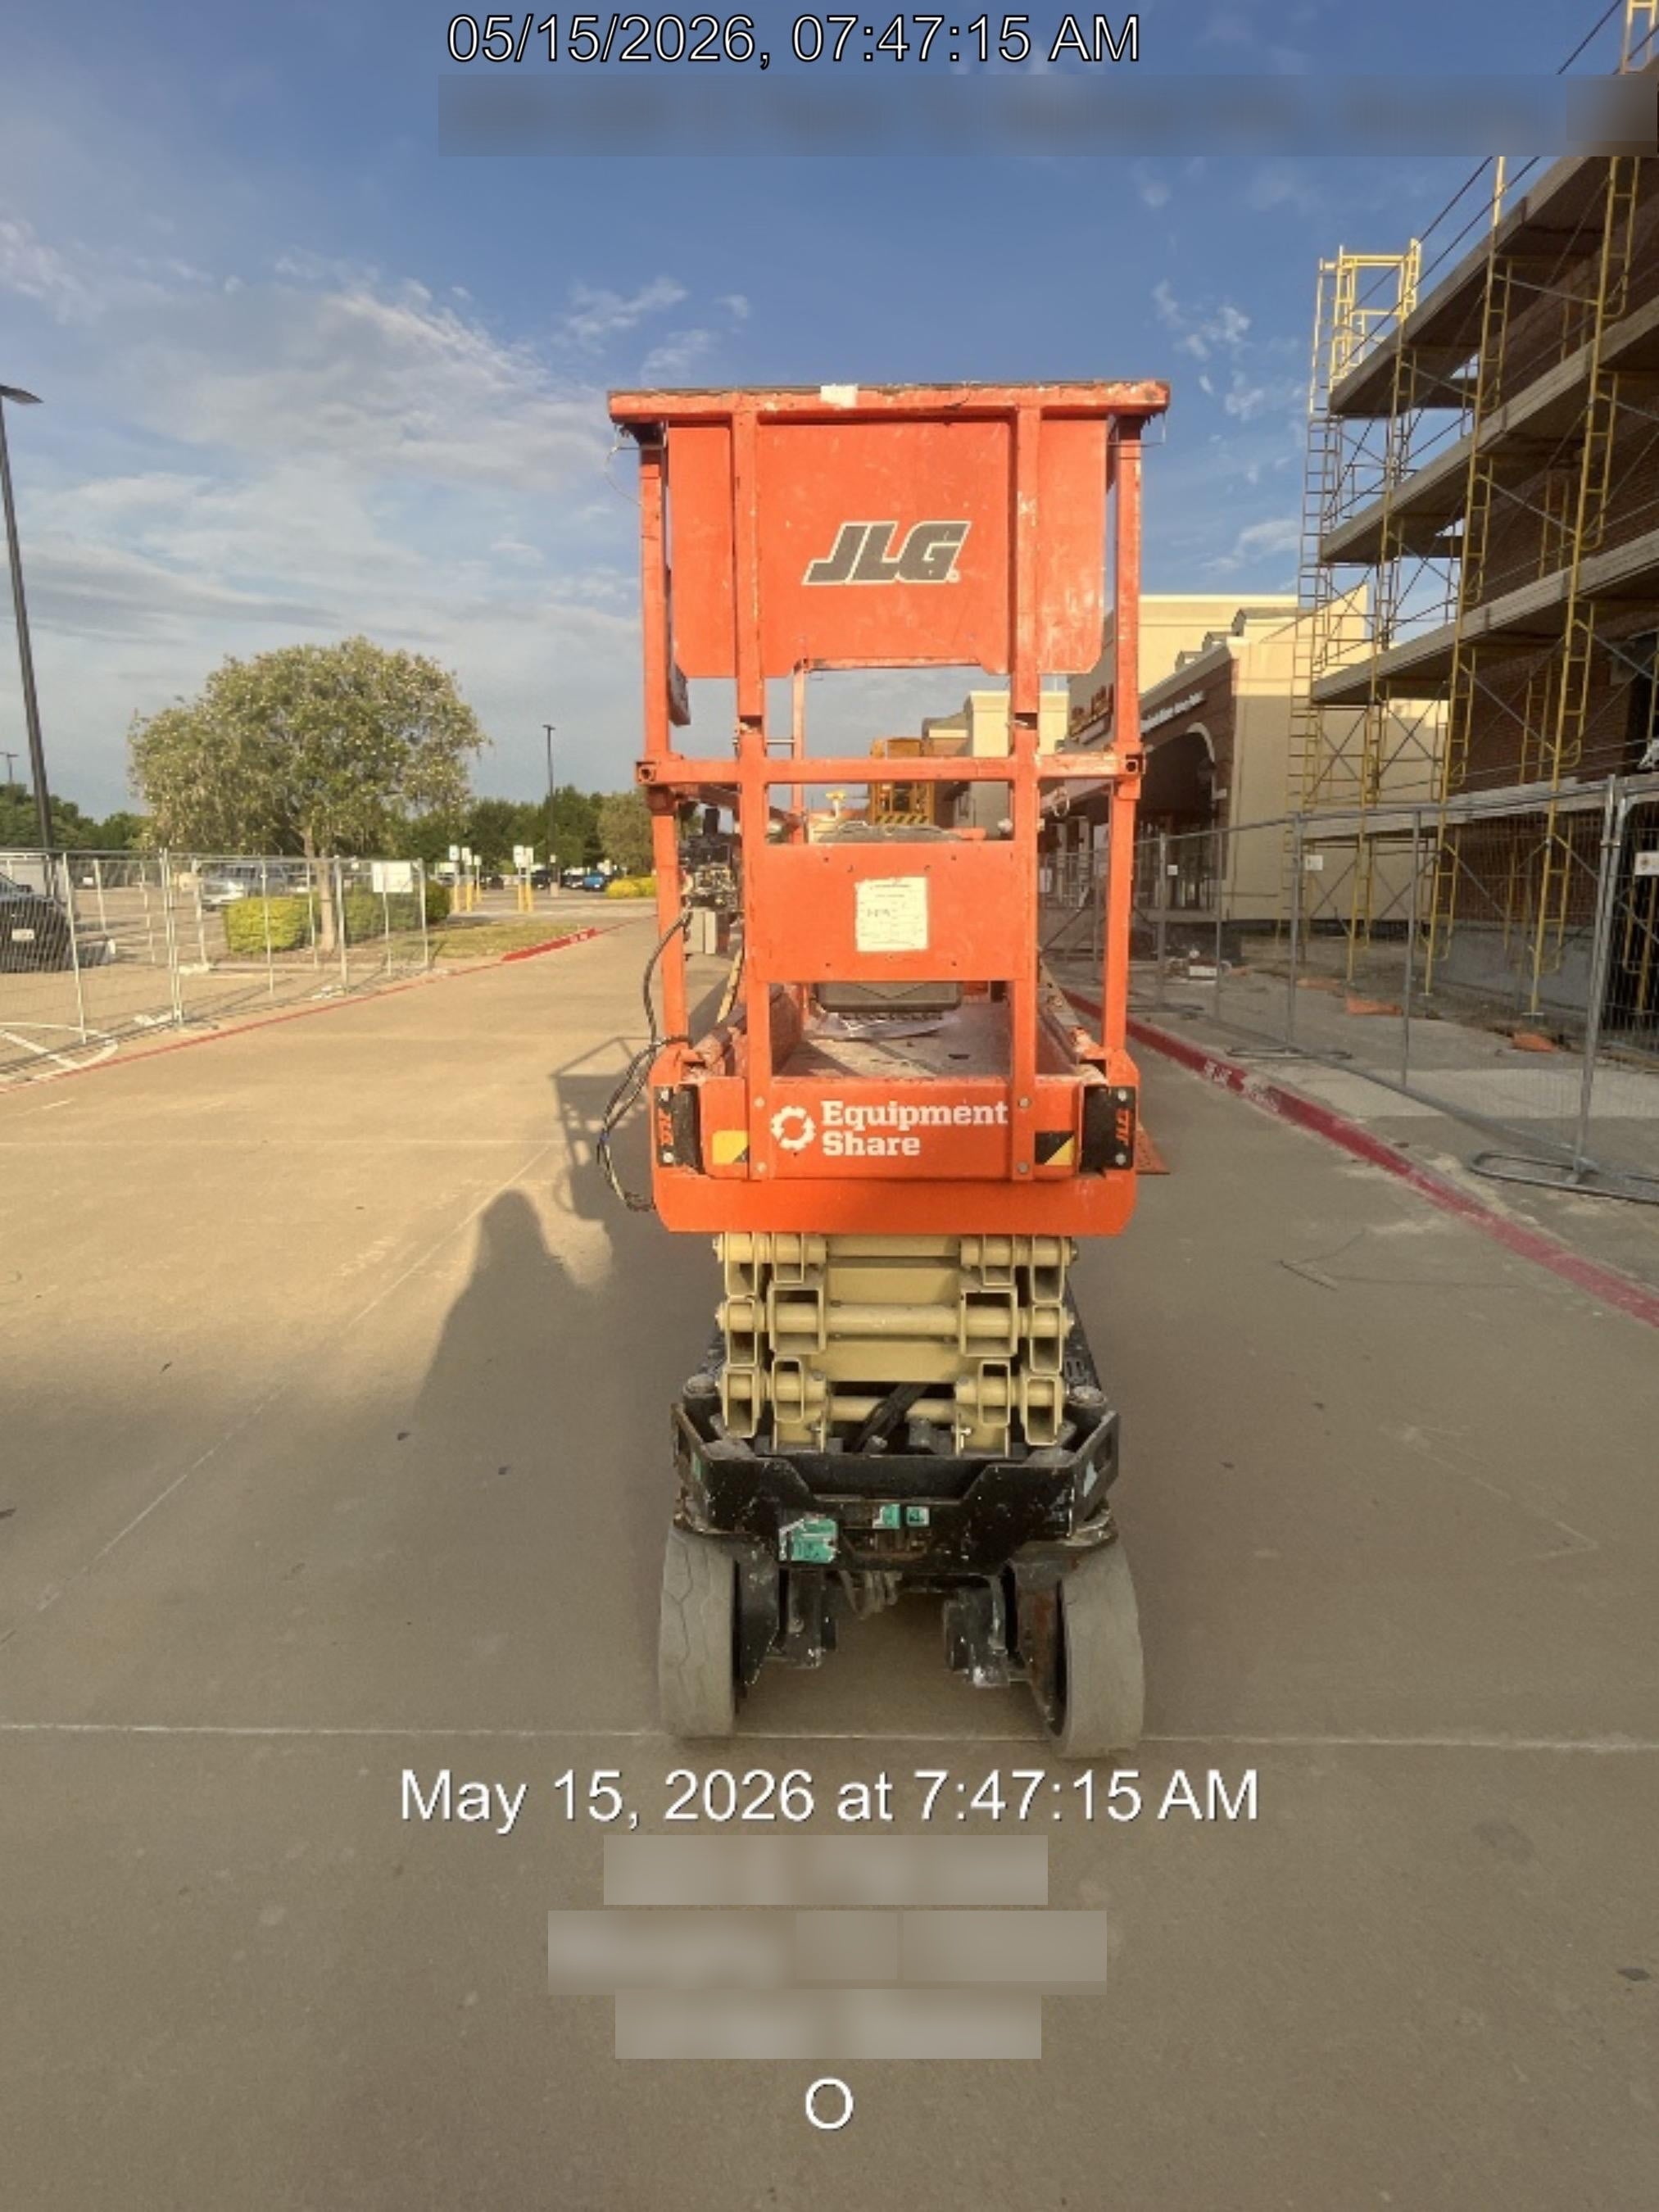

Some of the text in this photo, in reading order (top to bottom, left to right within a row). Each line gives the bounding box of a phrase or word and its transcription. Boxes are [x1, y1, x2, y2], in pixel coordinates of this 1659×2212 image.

[801, 520, 971, 585] JLG
[820, 1099, 1009, 1131] Equipment
[822, 1130, 921, 1156] Share
